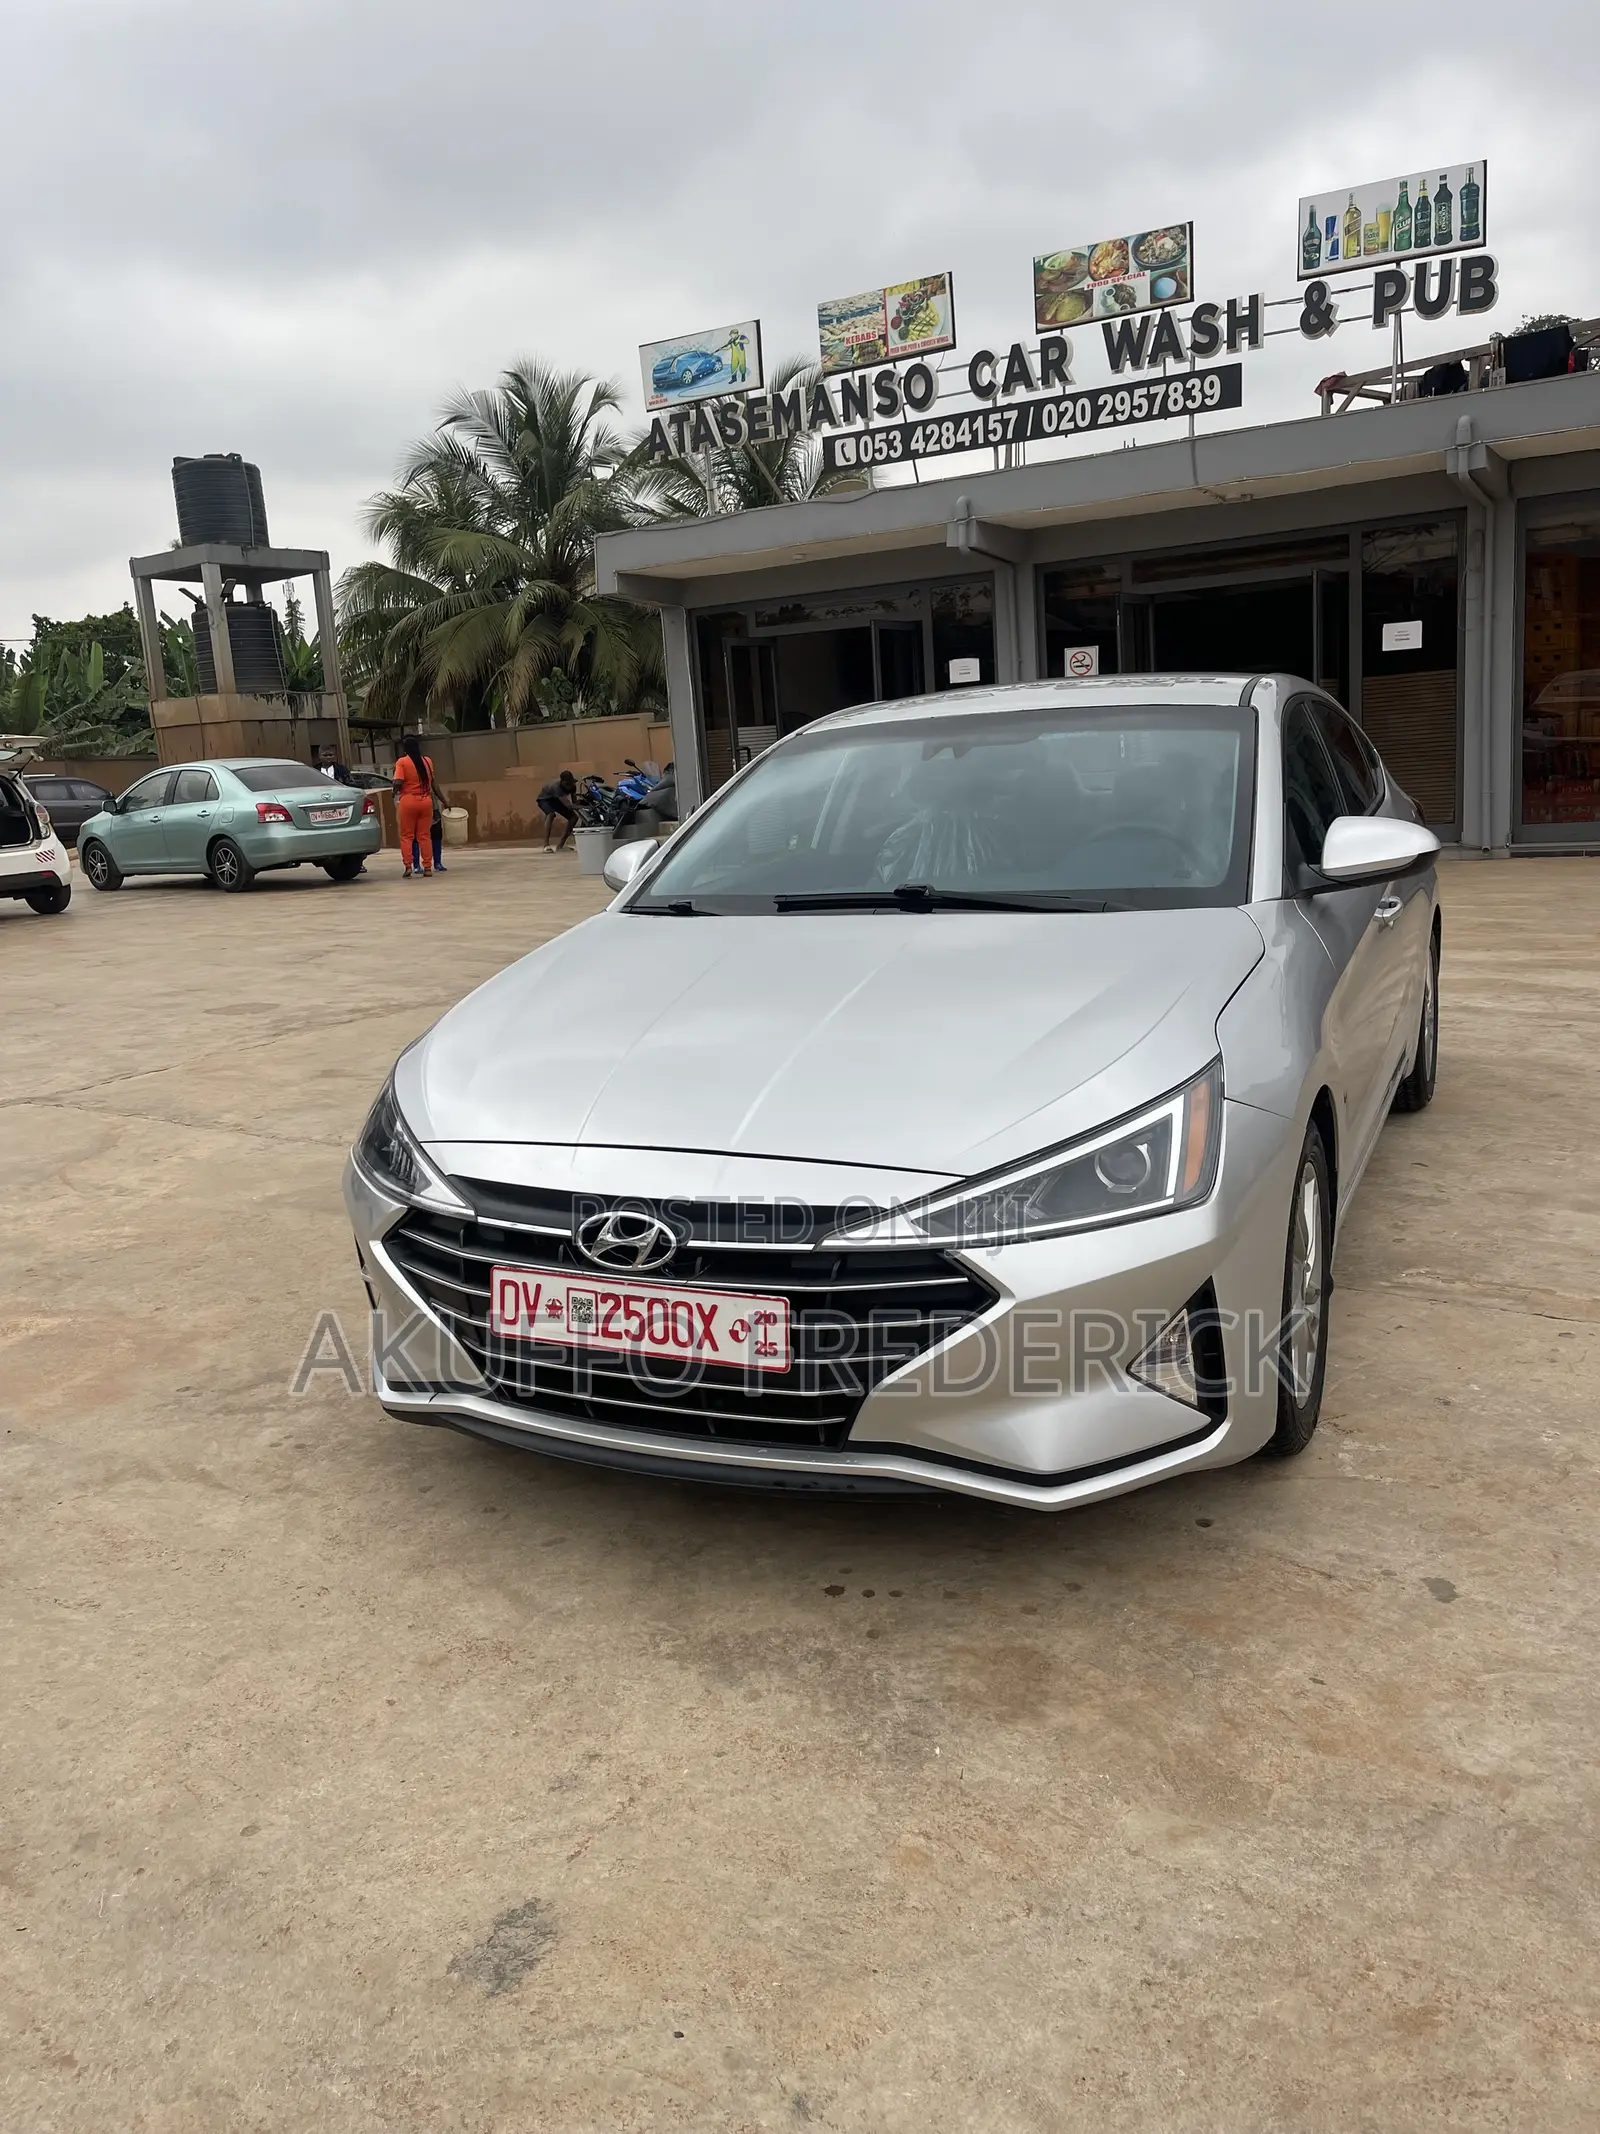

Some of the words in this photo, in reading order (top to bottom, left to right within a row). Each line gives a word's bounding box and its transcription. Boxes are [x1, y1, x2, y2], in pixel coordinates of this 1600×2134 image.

[1086, 280, 1109, 289] FOOD
[1110, 271, 1147, 283] SPECIAL
[648, 361, 938, 464] ATASEMANSO
[968, 335, 1076, 401] CAR
[1101, 292, 1265, 374] WASH
[1300, 280, 1340, 340] &
[1372, 254, 1499, 330] PUB
[845, 331, 877, 345] KEBABS
[648, 398, 668, 406] WASH
[859, 430, 903, 463] 053
[910, 409, 1018, 454] 4284157
[1026, 406, 1034, 436] /
[1042, 398, 1092, 433] 020
[1097, 375, 1222, 425] 2957839
[499, 1279, 542, 1328] DV
[600, 1292, 719, 1352] 2500X
